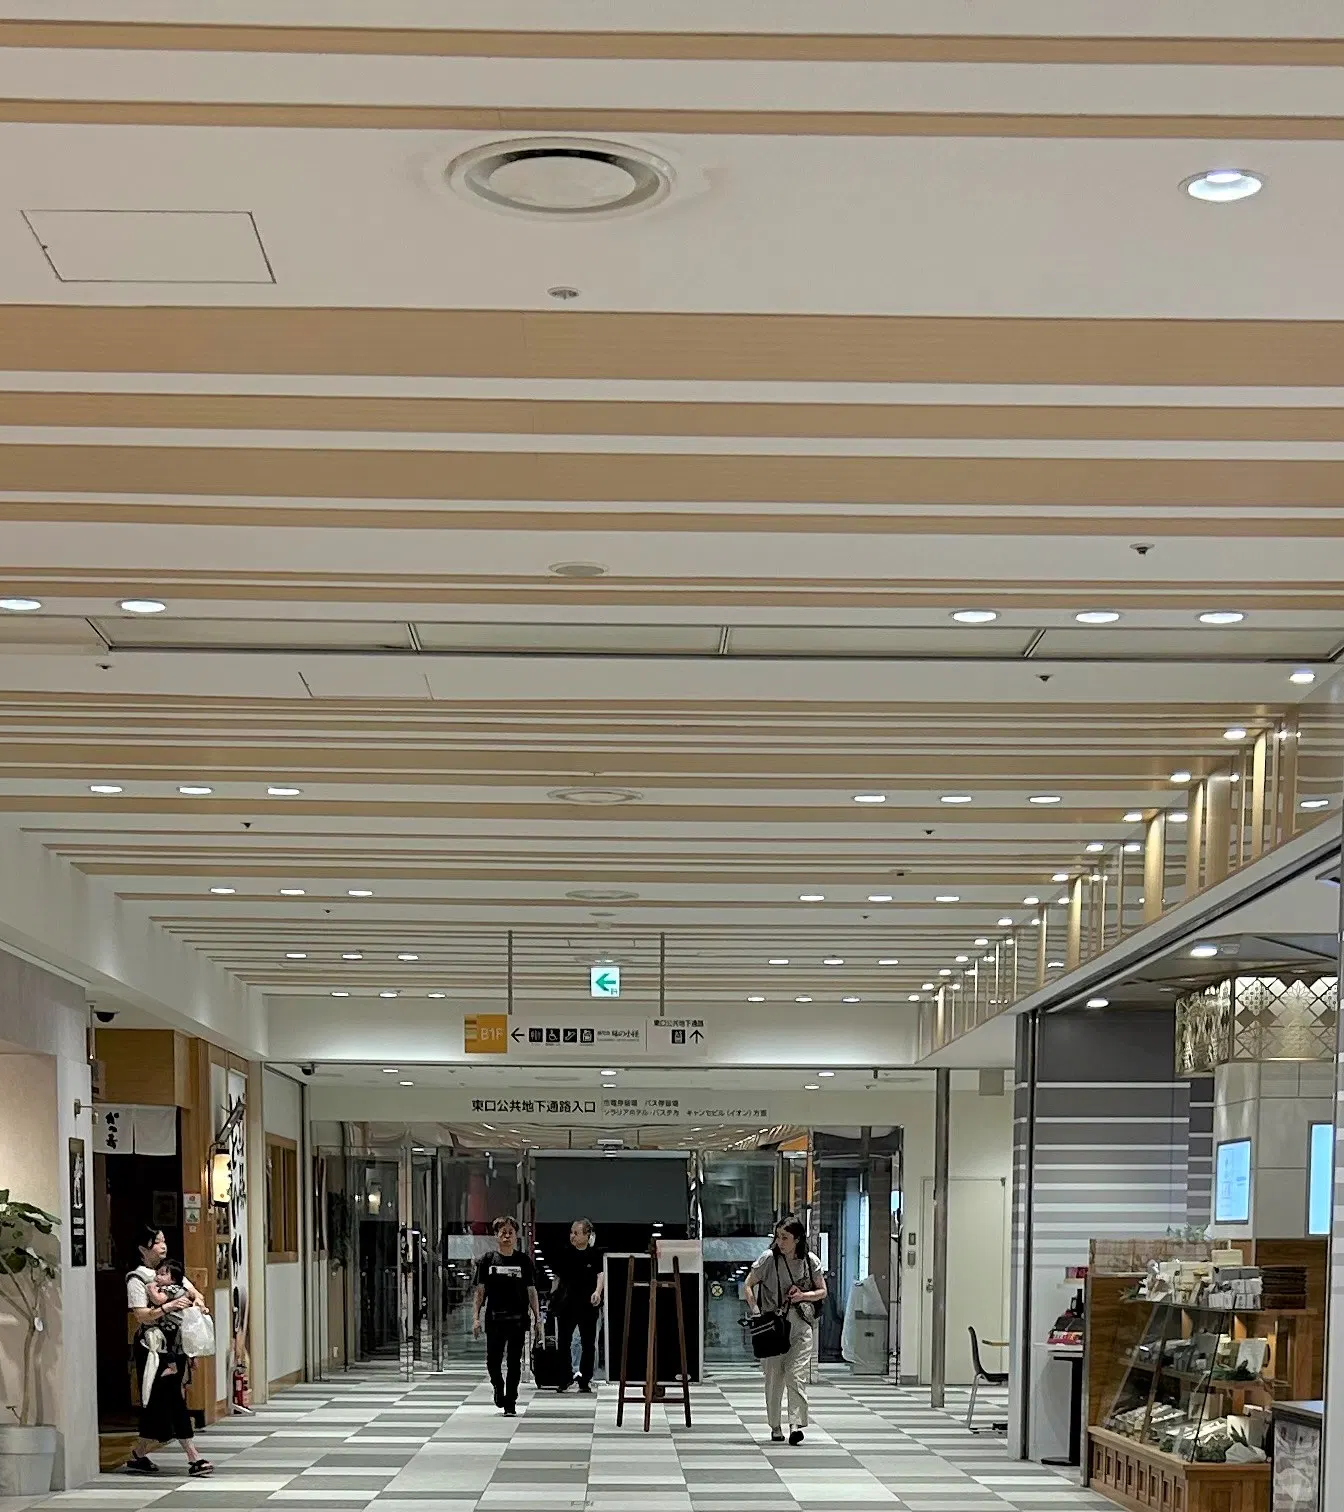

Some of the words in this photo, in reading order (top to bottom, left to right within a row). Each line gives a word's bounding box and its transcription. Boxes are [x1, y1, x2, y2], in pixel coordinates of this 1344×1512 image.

[480, 1027, 504, 1041] B1F
[472, 1099, 596, 1113] 東口公共地下通路入口
